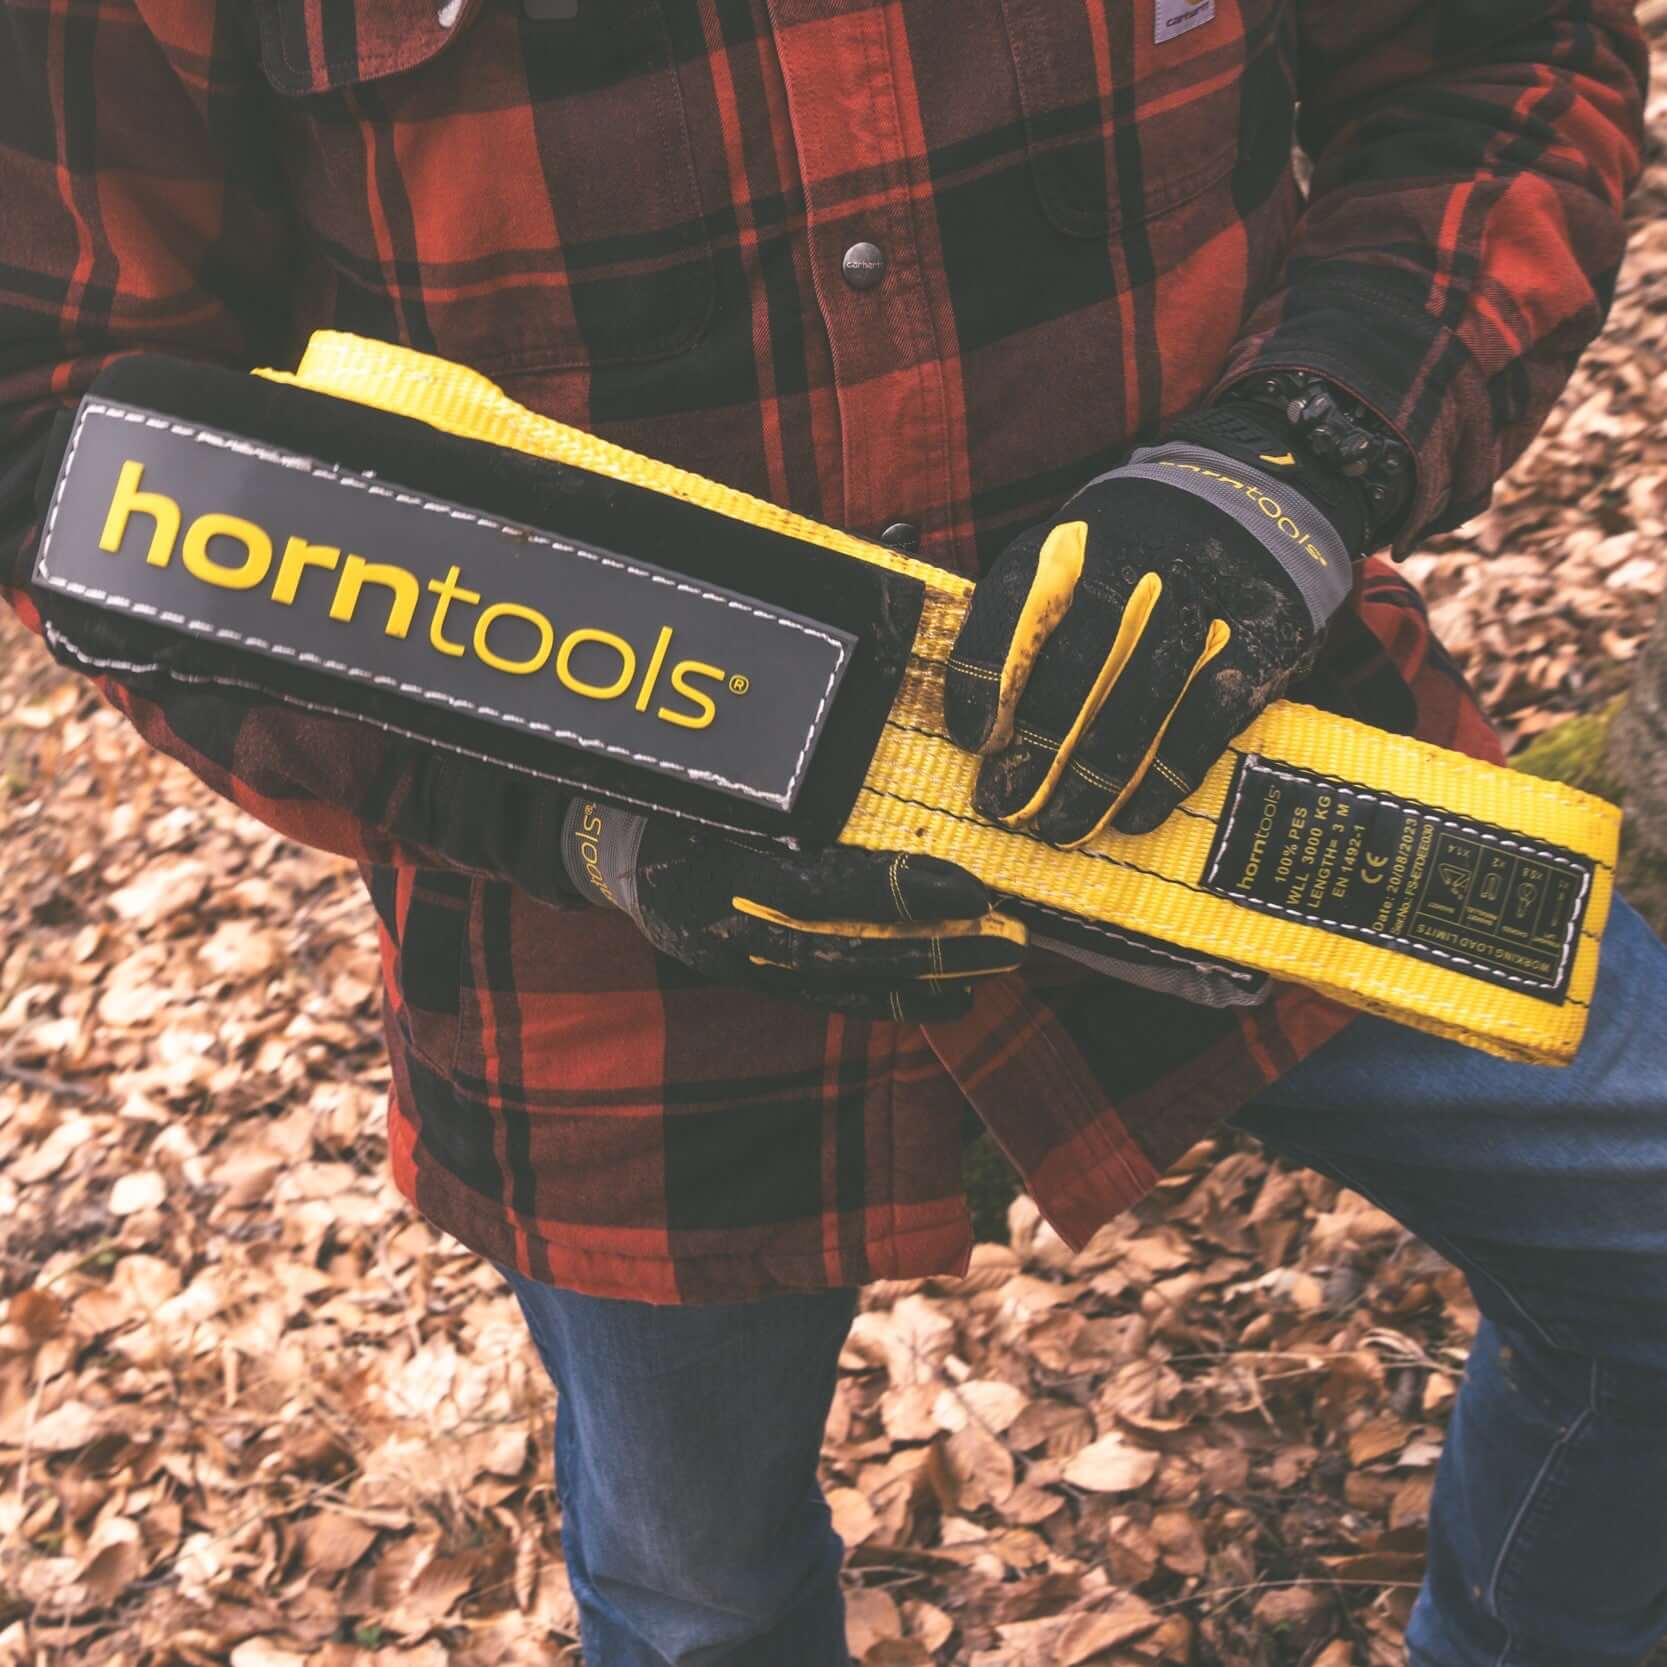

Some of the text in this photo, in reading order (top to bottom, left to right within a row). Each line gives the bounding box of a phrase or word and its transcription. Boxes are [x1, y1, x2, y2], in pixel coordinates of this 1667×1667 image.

[1275, 808, 1308, 881] 100% PES
[1286, 796, 1332, 905] WLL 3000 KG
[1308, 804, 1350, 909] LENGTH= 3 M
[1330, 825, 1365, 898] EN 1492-1
[1361, 852, 1388, 884] CE
[1387, 818, 1417, 895] 20/08/2023
[1416, 924, 1459, 943] LIMITS
[1459, 937, 1494, 955] LOAD
